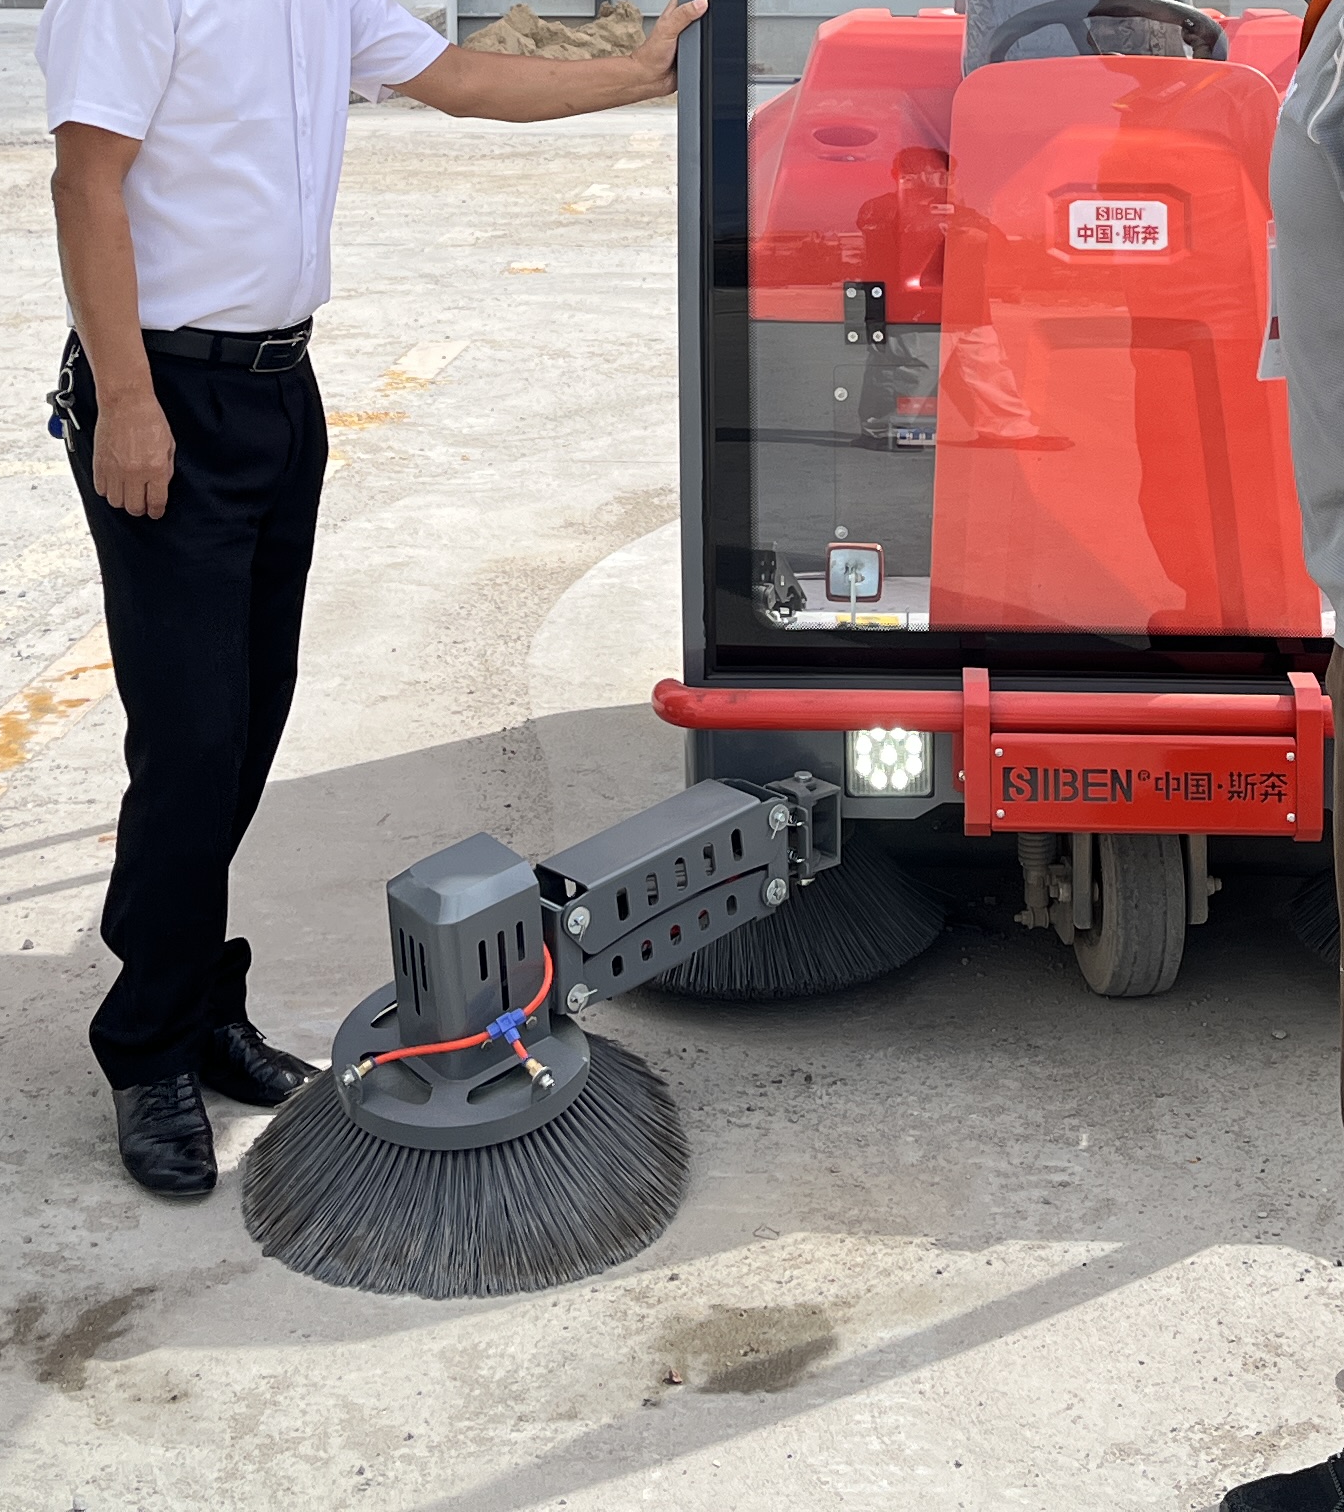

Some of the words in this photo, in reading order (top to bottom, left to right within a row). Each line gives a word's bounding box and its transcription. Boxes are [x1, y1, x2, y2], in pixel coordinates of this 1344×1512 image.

[1077, 224, 1160, 244] 中国·斯奔
[1154, 771, 1289, 804] 中国·斯奔
